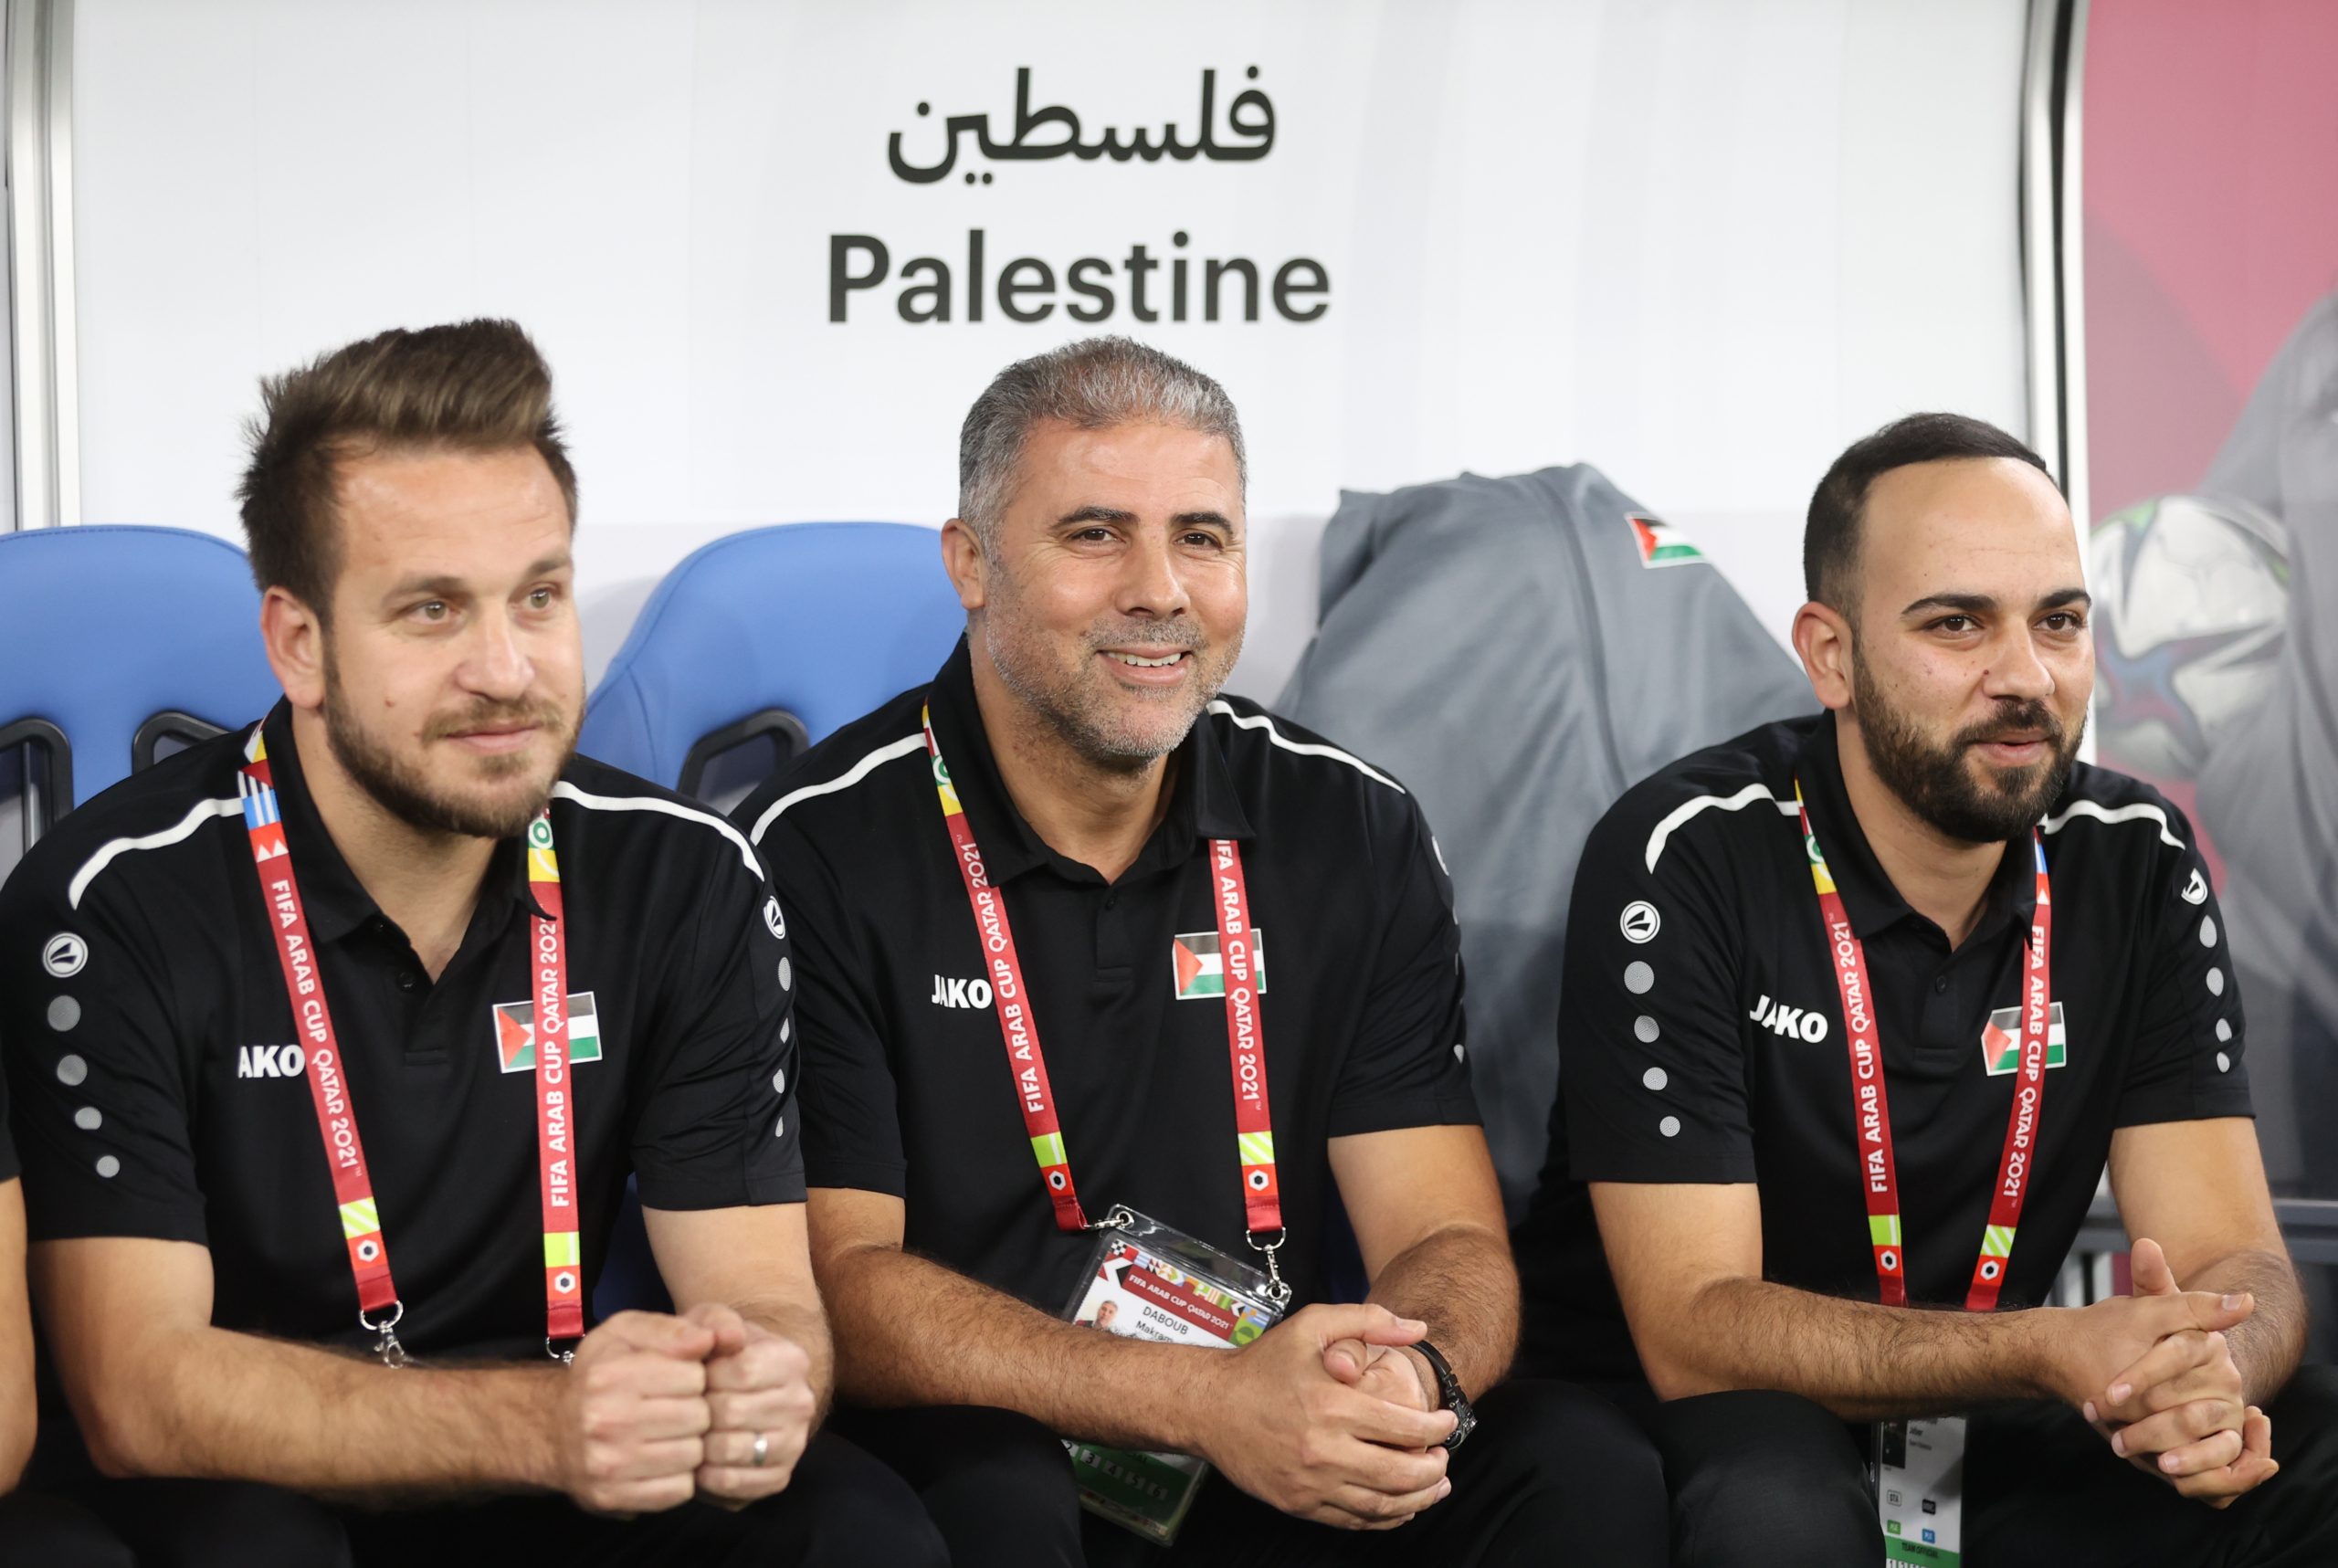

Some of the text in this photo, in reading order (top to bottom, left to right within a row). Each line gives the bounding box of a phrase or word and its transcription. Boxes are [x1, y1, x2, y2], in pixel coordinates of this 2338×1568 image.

[888, 65, 1277, 184] فلسطين
[828, 228, 1331, 323] Palestine
[1216, 839, 1234, 870] IFA
[271, 879, 298, 929] FIFA
[1220, 877, 1243, 935] ARAB
[285, 934, 315, 994] ARAB
[1228, 940, 1248, 982] CUP
[2031, 925, 2045, 970] FIFA
[932, 973, 993, 1009] JAKO
[961, 843, 1045, 1112] FIFA ARAB CUP QATAR 2021
[302, 999, 327, 1043] CUP
[1229, 987, 1255, 1050] QATAR
[1749, 994, 1828, 1044] JAKO
[2028, 975, 2045, 1035] ARAB
[237, 1044, 306, 1079] AKO
[311, 1048, 344, 1115] QATAR
[539, 917, 570, 1207] FIFA ARAB CUP QATAR 202
[1238, 1054, 1260, 1100] 2021
[1831, 921, 1888, 1193] FIFA ARAB CUP QATAR 2021
[2025, 1040, 2042, 1081] CUP
[331, 1117, 359, 1168] 2021
[2014, 1086, 2037, 1149] QATAR
[2003, 1152, 2026, 1197] 2021
[1129, 1274, 1229, 1330] FIFA ARAB CUP QATAR 2021
[1143, 1306, 1189, 1334] DABOUB
[1135, 1320, 1174, 1342] Makram
[1086, 1453, 1095, 1464] 3
[1109, 1466, 1117, 1477] 4
[1132, 1476, 1140, 1487] 5
[1153, 1487, 1162, 1498] 6
